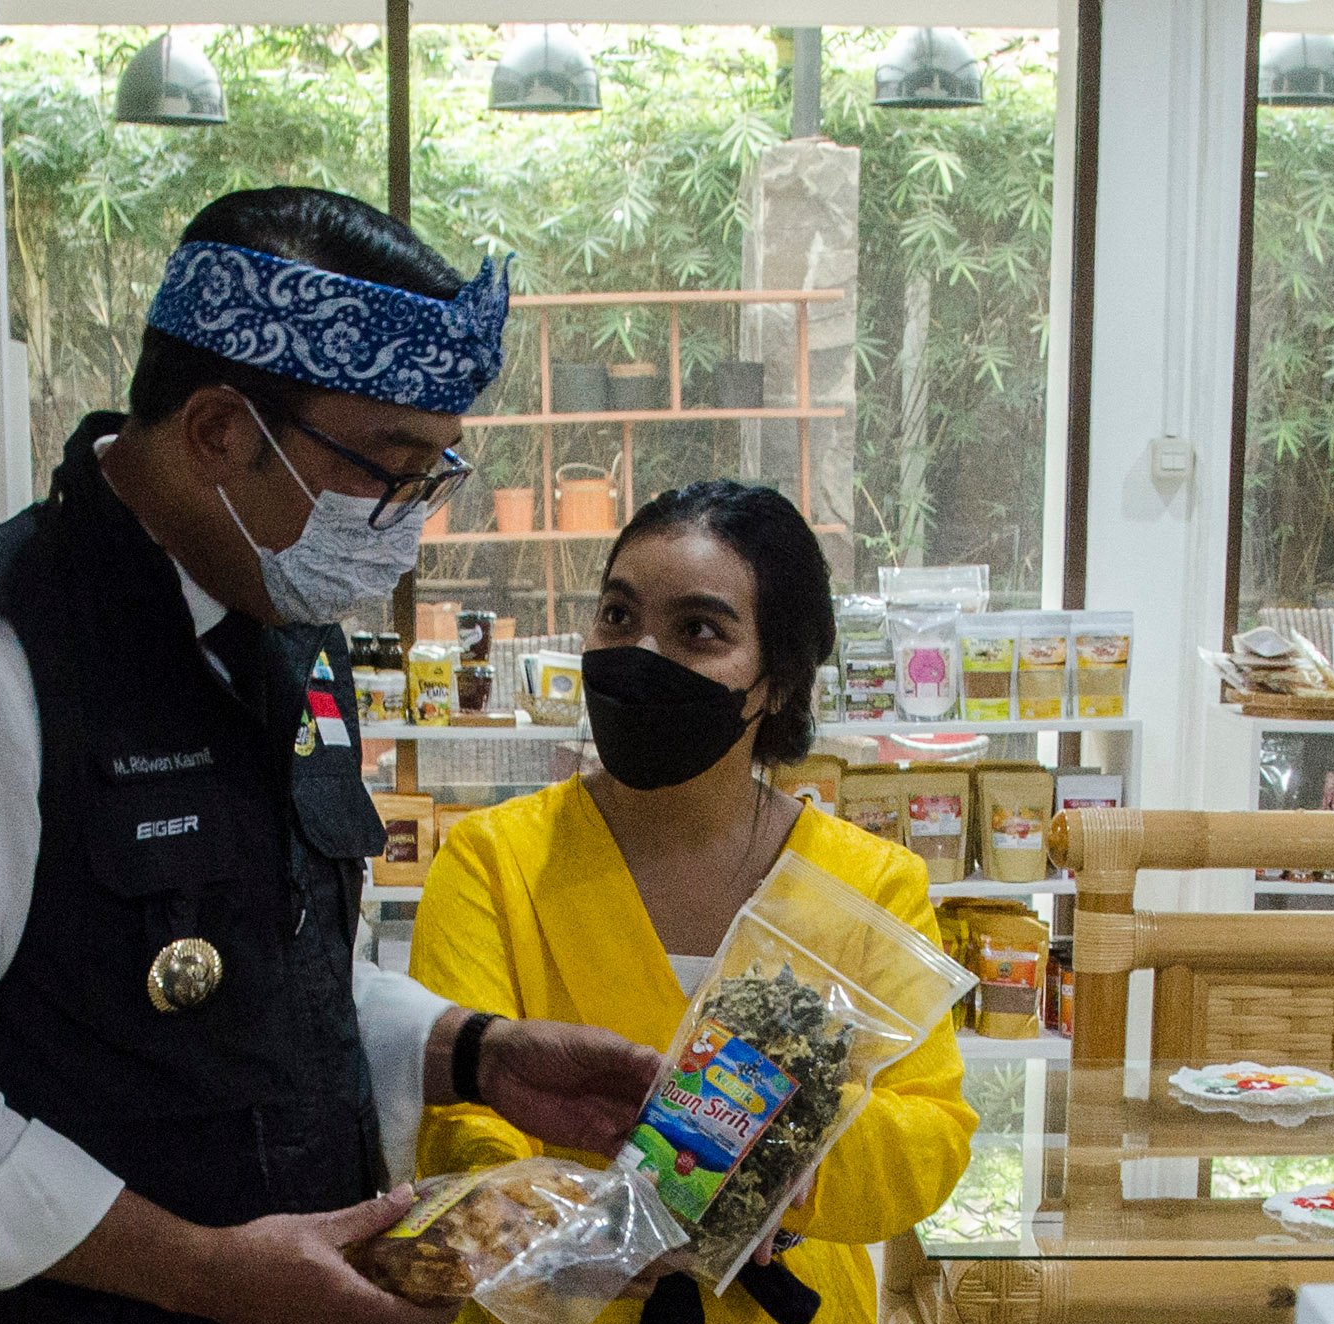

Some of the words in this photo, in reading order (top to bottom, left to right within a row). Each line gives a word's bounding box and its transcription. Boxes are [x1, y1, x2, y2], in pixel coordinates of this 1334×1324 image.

[136, 815, 199, 840] EIGER
[660, 1081, 702, 1115] Daun
[704, 1097, 750, 1138] Sirih
